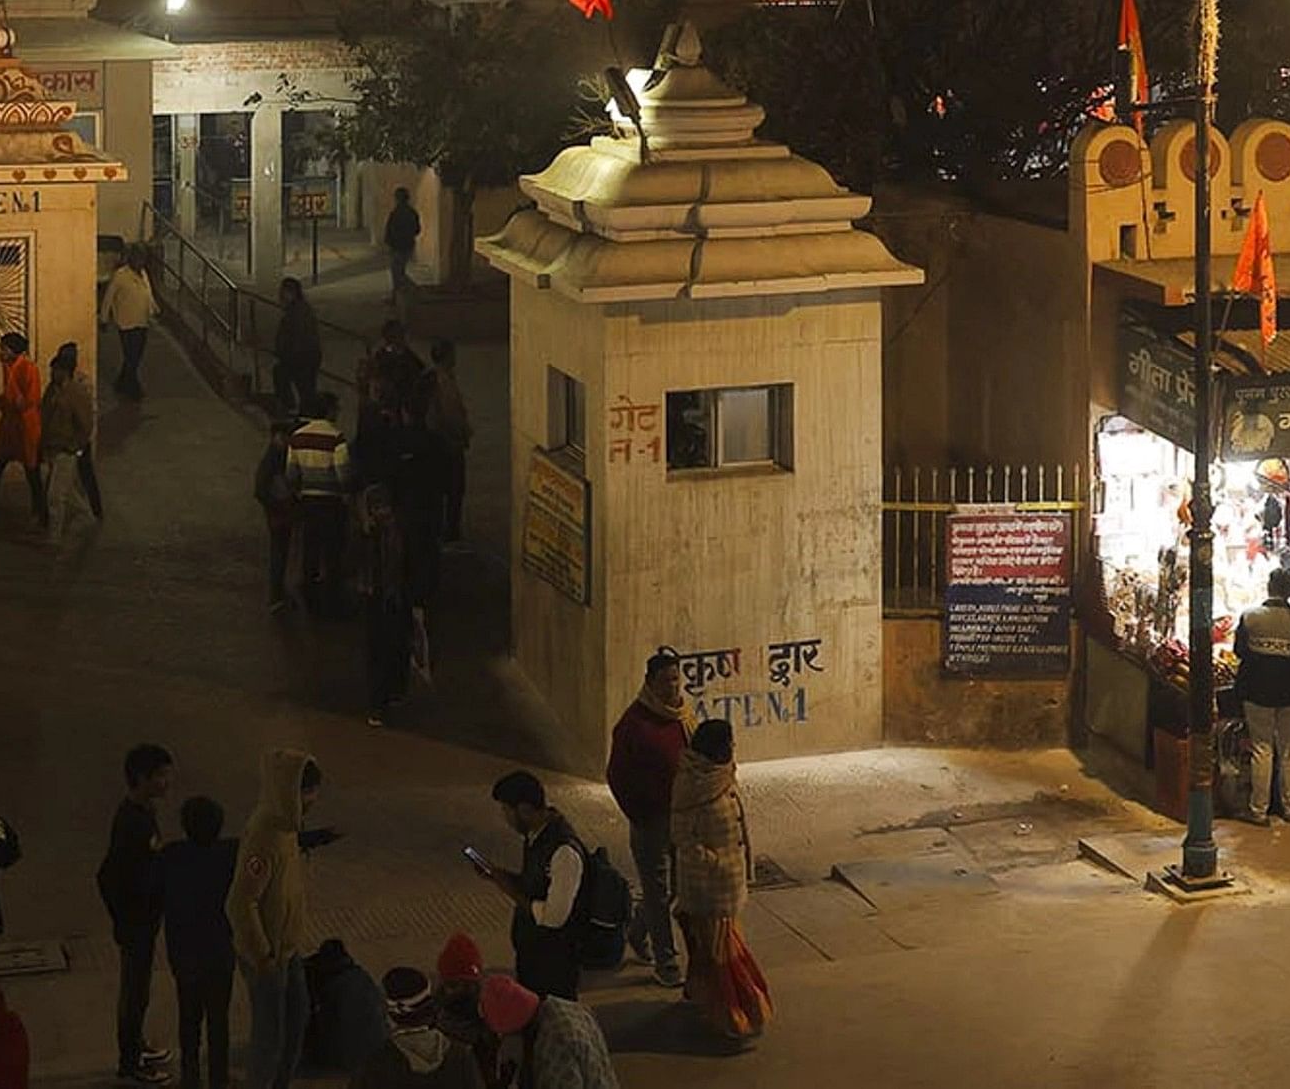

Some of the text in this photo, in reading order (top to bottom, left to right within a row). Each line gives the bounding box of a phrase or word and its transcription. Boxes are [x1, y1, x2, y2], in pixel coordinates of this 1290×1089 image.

[39, 70, 99, 93] कास
[1128, 349, 1172, 391] गीता
[610, 395, 661, 432] गेट
[768, 639, 825, 688] द्वार
[695, 693, 762, 727] ATE
